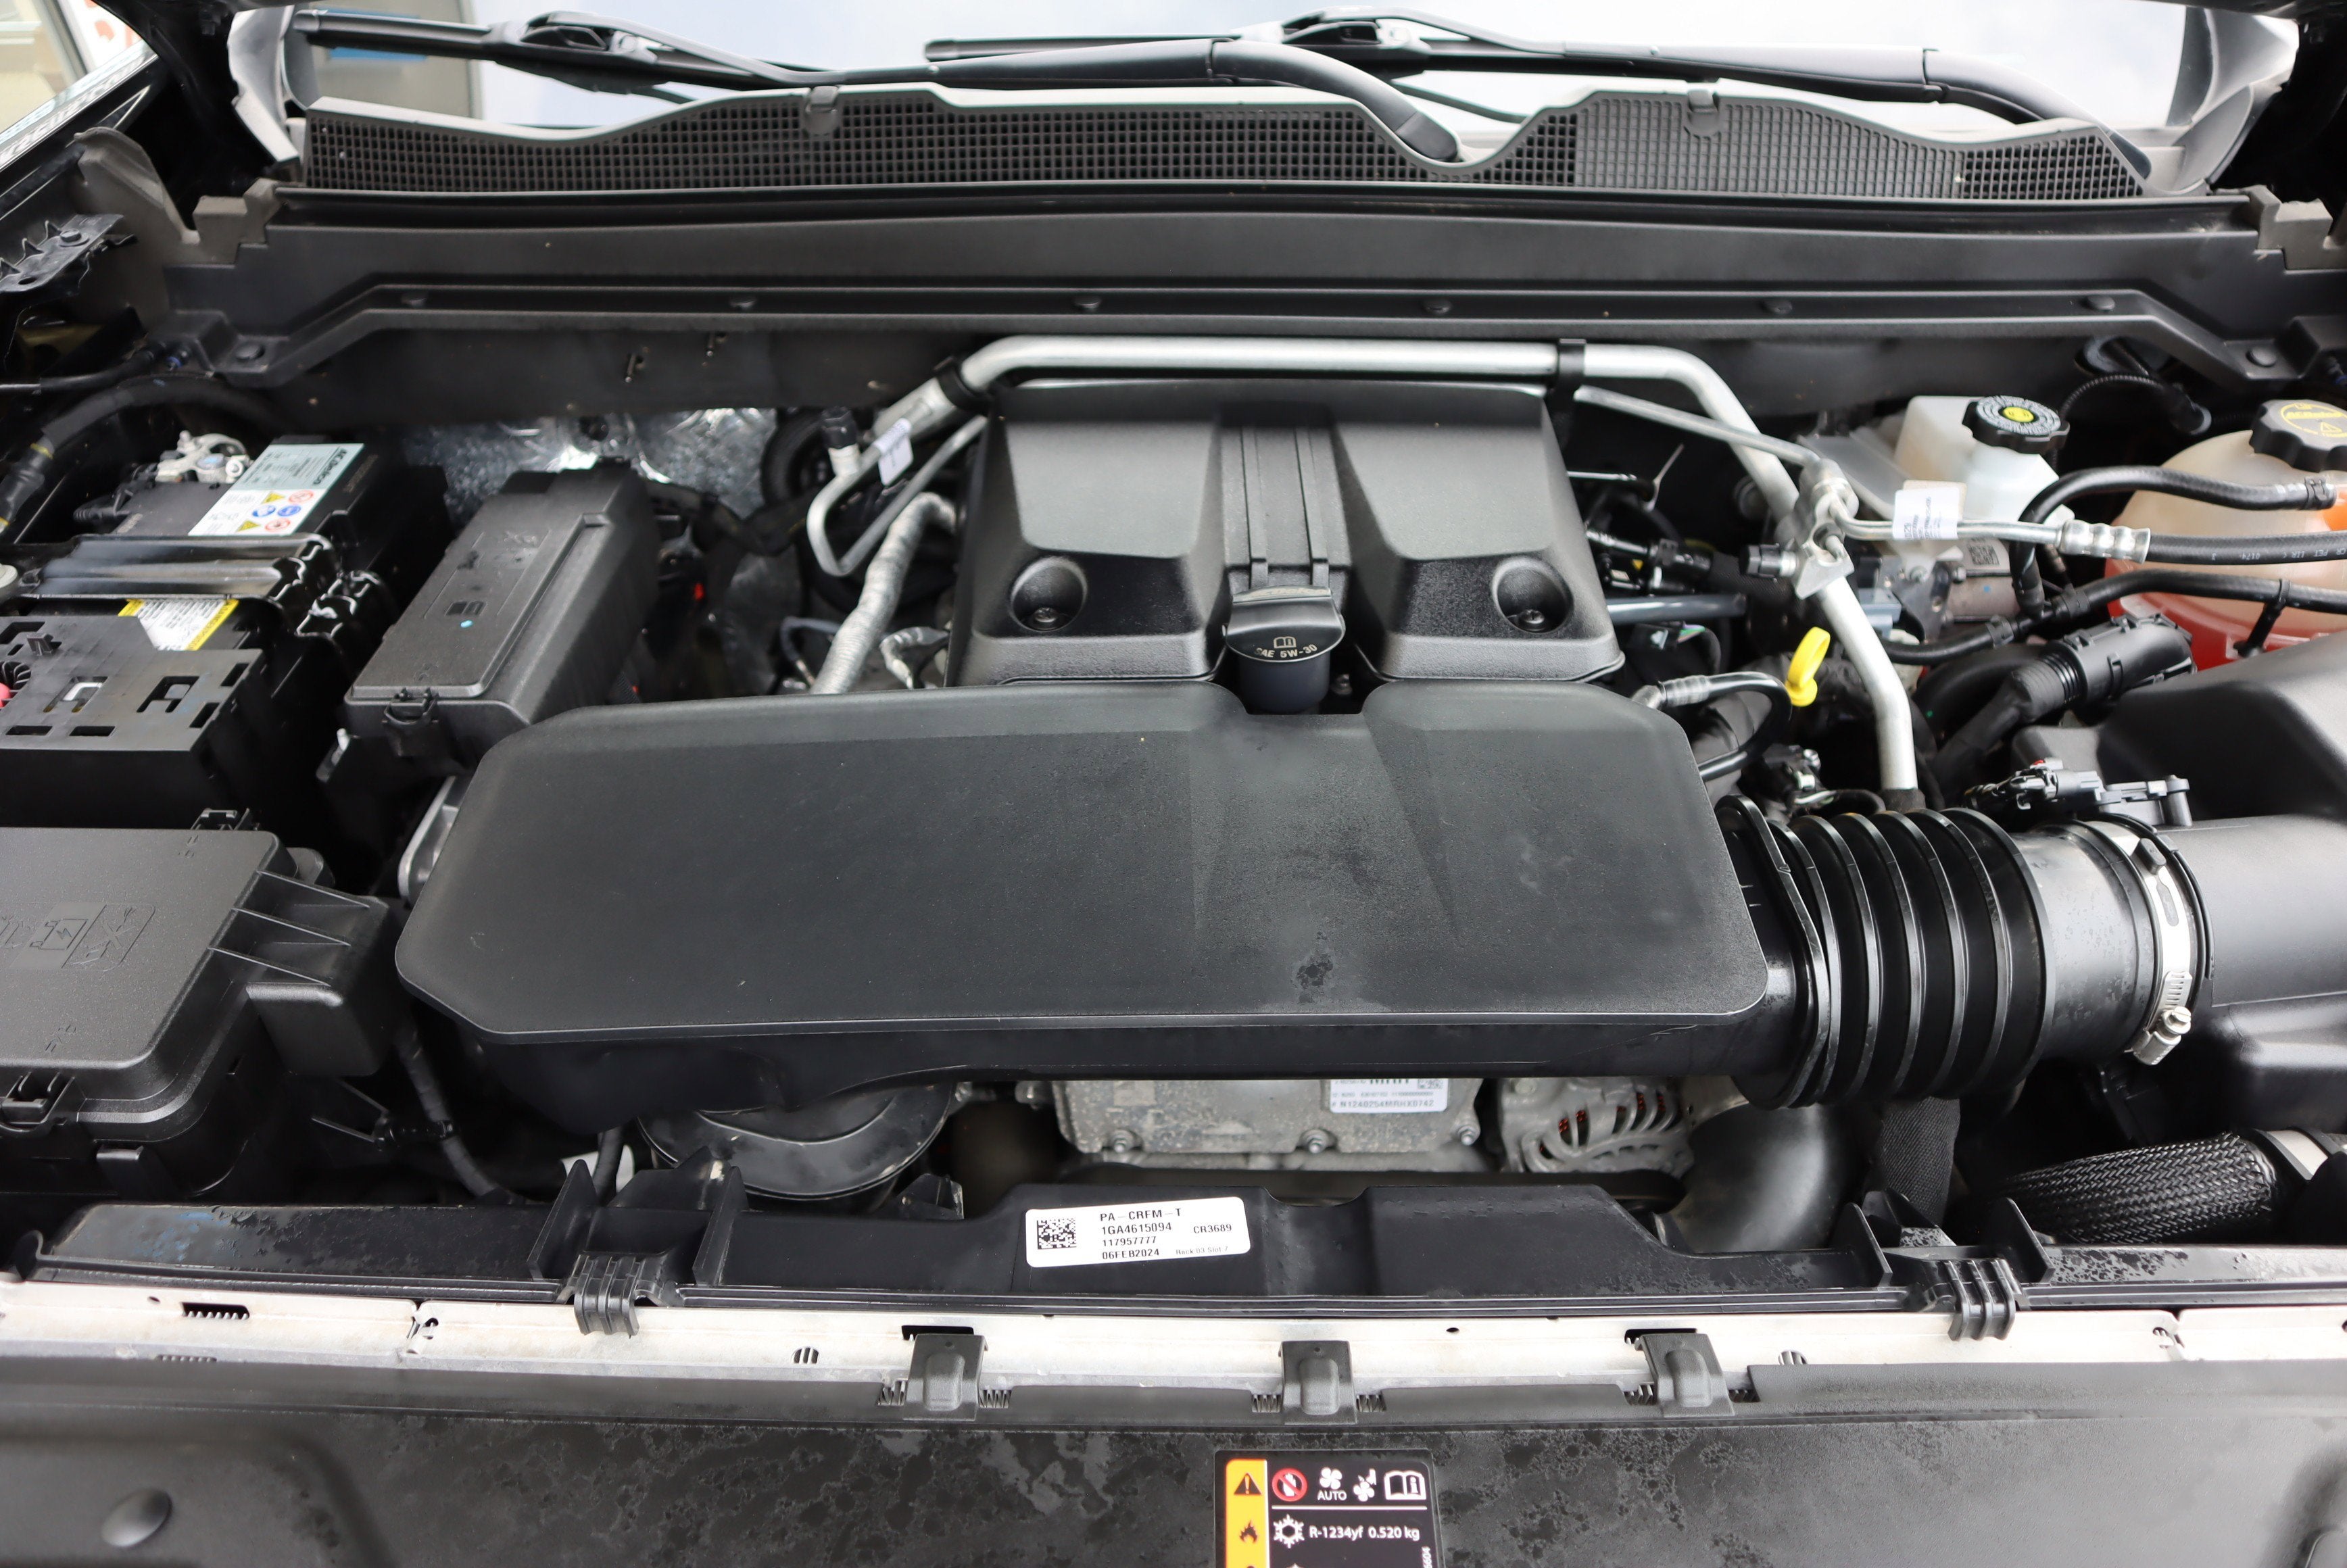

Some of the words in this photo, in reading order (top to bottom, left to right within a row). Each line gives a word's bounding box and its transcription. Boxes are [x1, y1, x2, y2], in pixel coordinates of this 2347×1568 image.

[1254, 647, 1276, 658] SAE
[1280, 643, 1317, 658] 5W-30
[1101, 1222, 1172, 1235] 1GA4615094
[1193, 1223, 1232, 1233] CR3689
[1103, 1236, 1157, 1247] 117957777
[1102, 1248, 1160, 1260] 06FEB2024
[1317, 1490, 1347, 1500] AUTO
[1309, 1525, 1363, 1541] R-1234yf
[1368, 1526, 1402, 1538] 0.520
[1404, 1525, 1420, 1542] kg
